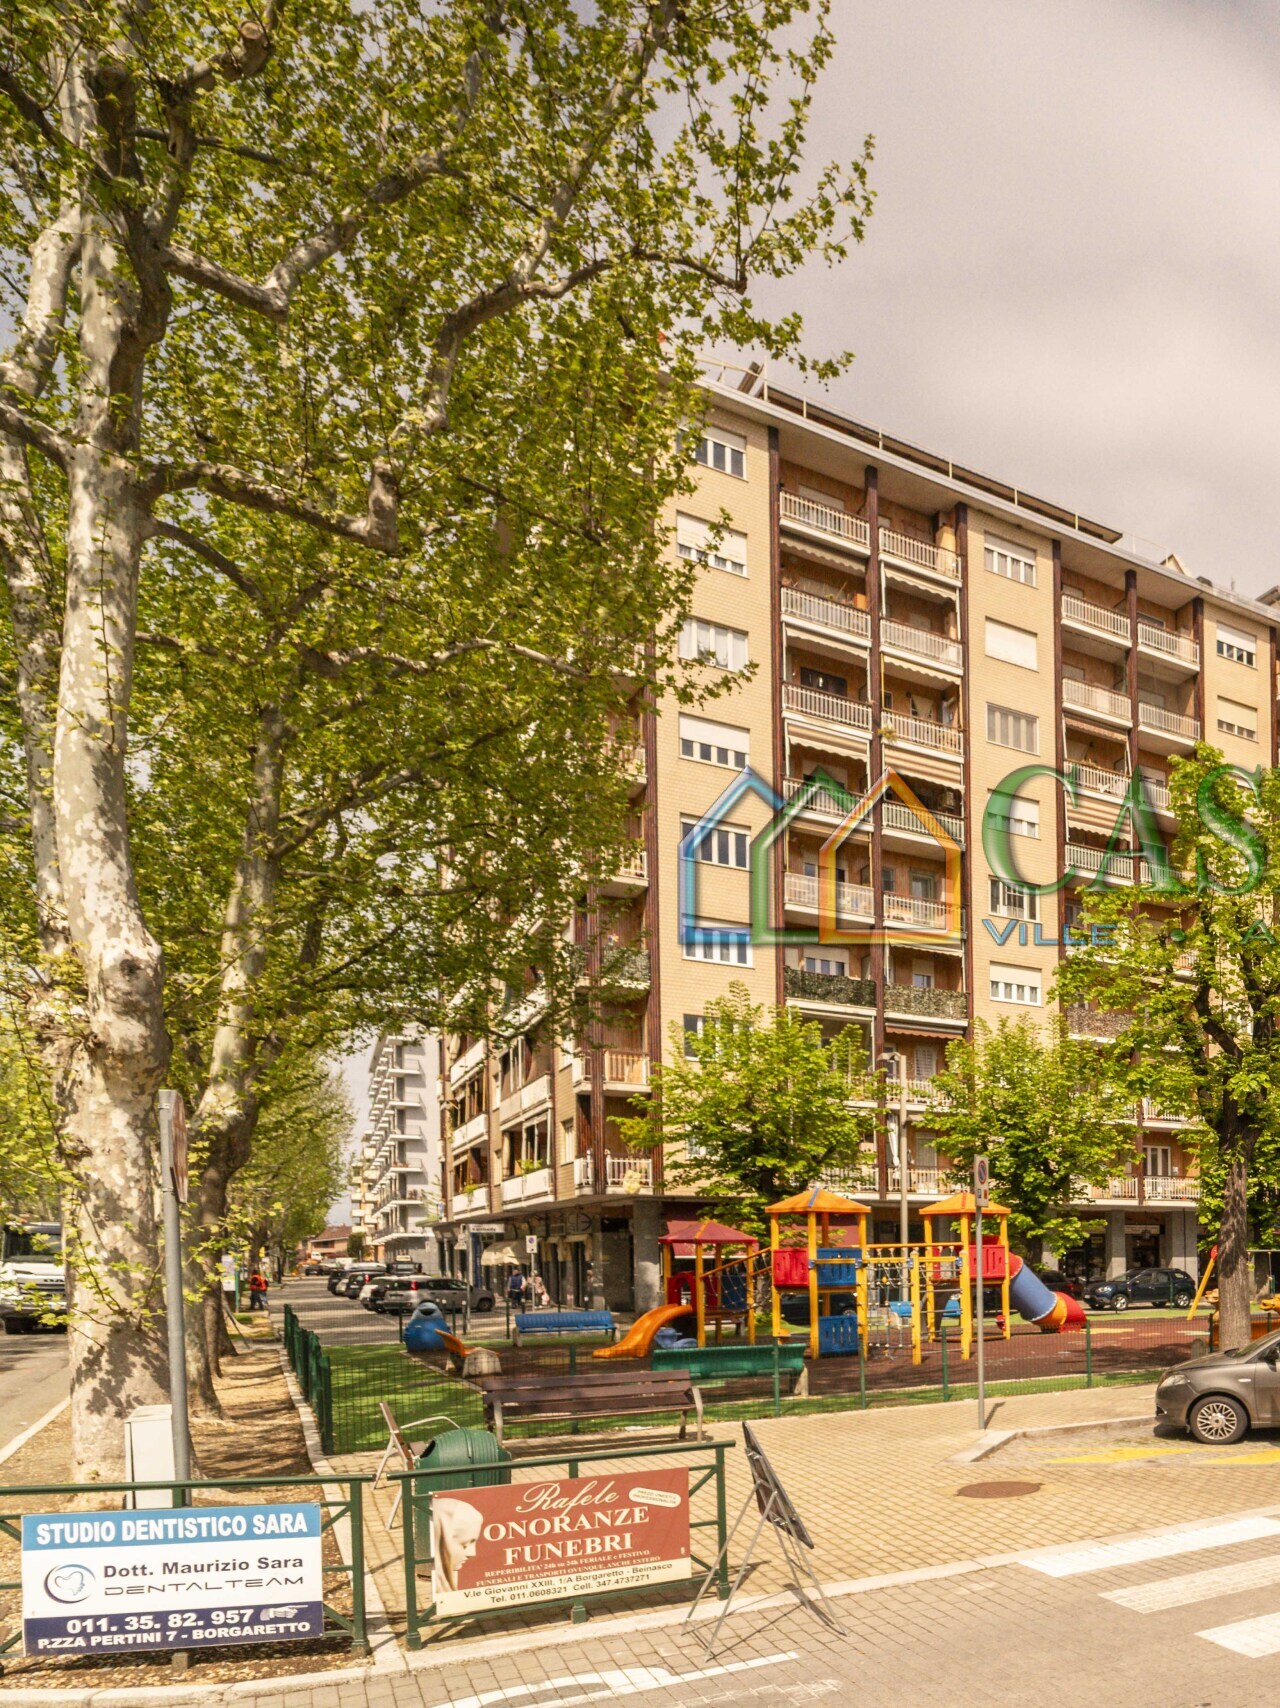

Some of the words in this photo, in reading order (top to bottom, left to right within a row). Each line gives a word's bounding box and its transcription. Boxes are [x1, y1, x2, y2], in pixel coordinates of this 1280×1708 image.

[515, 1480, 620, 1515] Rafele
[36, 1520, 116, 1546] STUDIO
[121, 1515, 247, 1542] DENTISTICO
[252, 1512, 308, 1535] SARA
[483, 1506, 650, 1542] ONORANZE
[504, 1532, 633, 1566] FUNEBRI
[580, 1555, 612, 1565] FERIALE
[619, 1550, 650, 1559] FESTIVO
[104, 1564, 154, 1578] Dott.
[162, 1558, 250, 1575] Maurizio
[257, 1556, 303, 1570] Sara
[463, 1587, 482, 1599] V.le
[484, 1583, 529, 1597] Giovanni
[559, 1575, 573, 1585] 1/A
[575, 1569, 624, 1583] Borgaretto
[632, 1562, 672, 1574] Beinasco
[523, 1569, 566, 1580] TRASPORTI
[607, 1560, 632, 1570] ANCHE
[633, 1556, 661, 1565] ESTERO
[490, 1595, 507, 1605] Tel.
[510, 1586, 568, 1602] 011.0608321
[573, 1581, 594, 1592] Cell.
[596, 1573, 650, 1589] 347.4737271
[37, 1635, 86, 1650] P.ZZA
[91, 1631, 160, 1647] PERTINI
[166, 1631, 175, 1643] 7
[192, 1621, 311, 1641] BORGARETTO
[66, 1617, 117, 1634] 011.
[124, 1614, 160, 1631] 35.
[167, 1611, 204, 1628] 82.
[211, 1609, 255, 1624] 957
